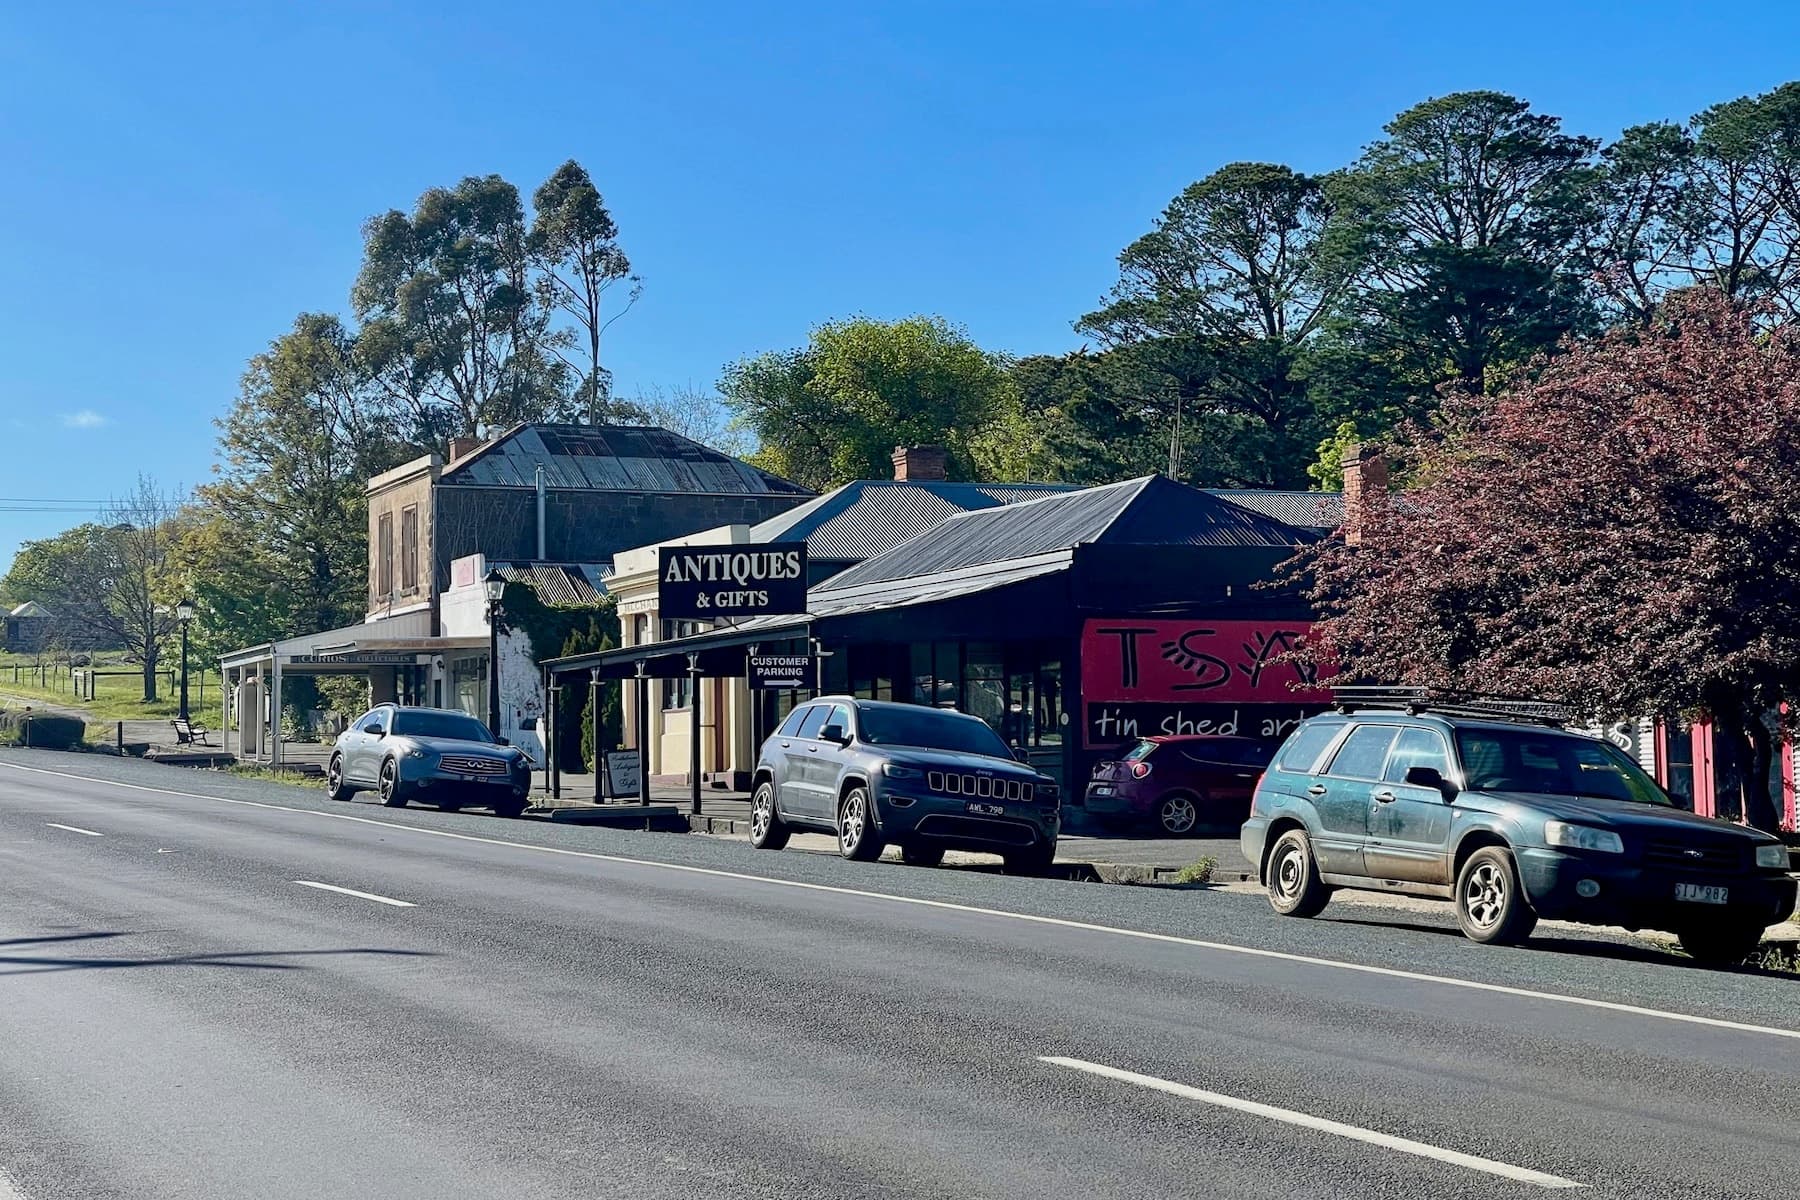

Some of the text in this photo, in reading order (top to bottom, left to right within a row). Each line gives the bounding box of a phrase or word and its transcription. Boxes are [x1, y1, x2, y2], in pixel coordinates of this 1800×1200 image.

[665, 551, 800, 586] ANTIQUES
[696, 590, 769, 608] & GIFTS
[301, 655, 347, 663] CURIOS
[751, 657, 809, 666] CUSTOMER
[757, 667, 804, 676] PARKING
[1095, 708, 1139, 737] tin
[1161, 710, 1238, 736] shed
